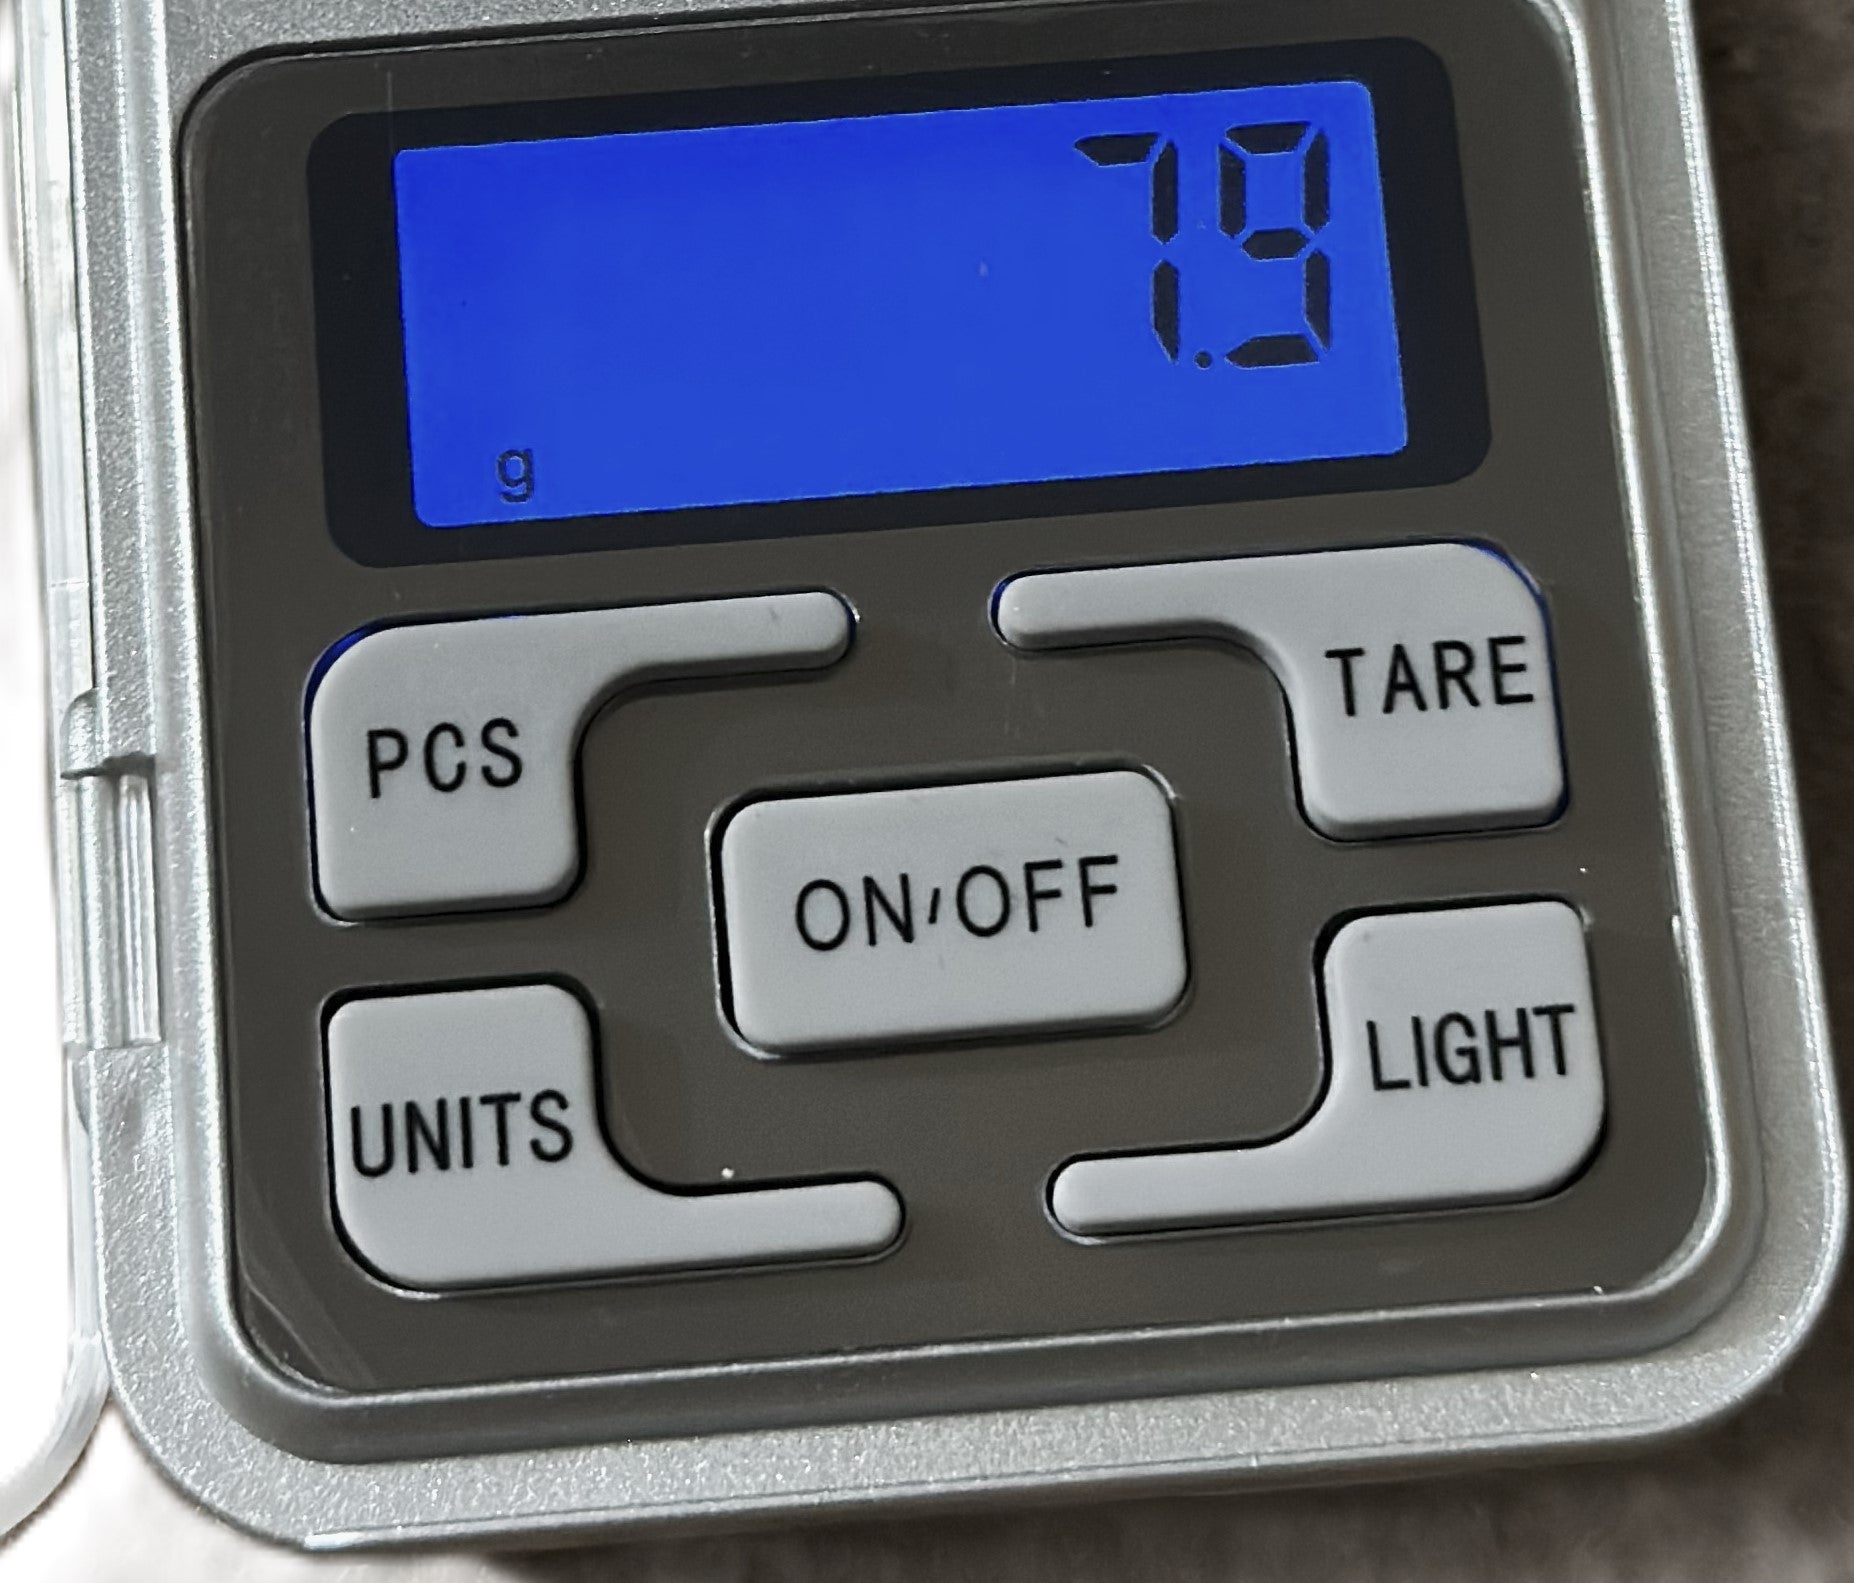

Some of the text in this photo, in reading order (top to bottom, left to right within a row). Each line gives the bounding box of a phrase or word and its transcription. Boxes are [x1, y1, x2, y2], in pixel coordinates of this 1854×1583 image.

[1074, 121, 1331, 369] 7.9
[497, 449, 535, 503] g
[1324, 635, 1535, 717] TARE
[366, 717, 523, 799] PCS
[794, 854, 1119, 952] ON/OFF
[1366, 1003, 1575, 1092] LIGHT
[350, 1089, 574, 1179] UNITS
